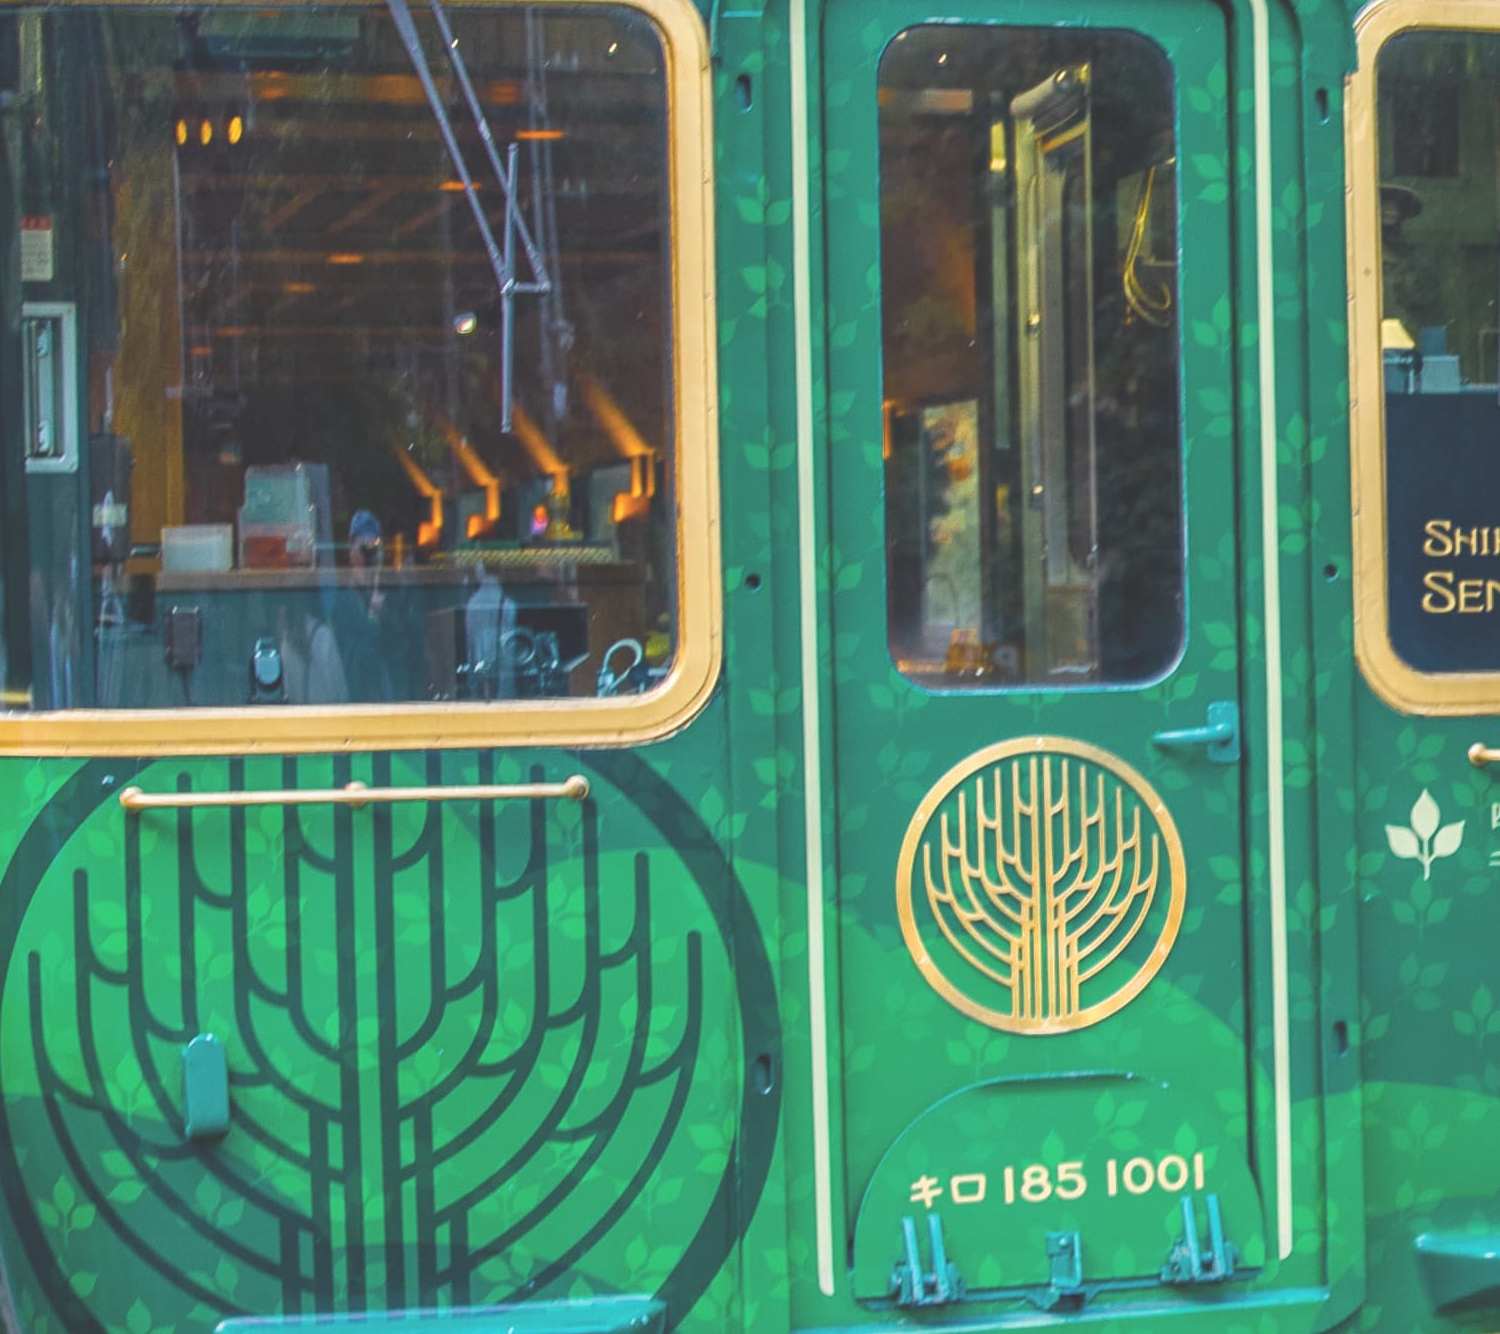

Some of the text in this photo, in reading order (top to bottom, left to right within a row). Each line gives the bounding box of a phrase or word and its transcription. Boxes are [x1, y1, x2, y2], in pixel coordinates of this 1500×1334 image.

[910, 1153, 1205, 1208] キロ 185 1001
